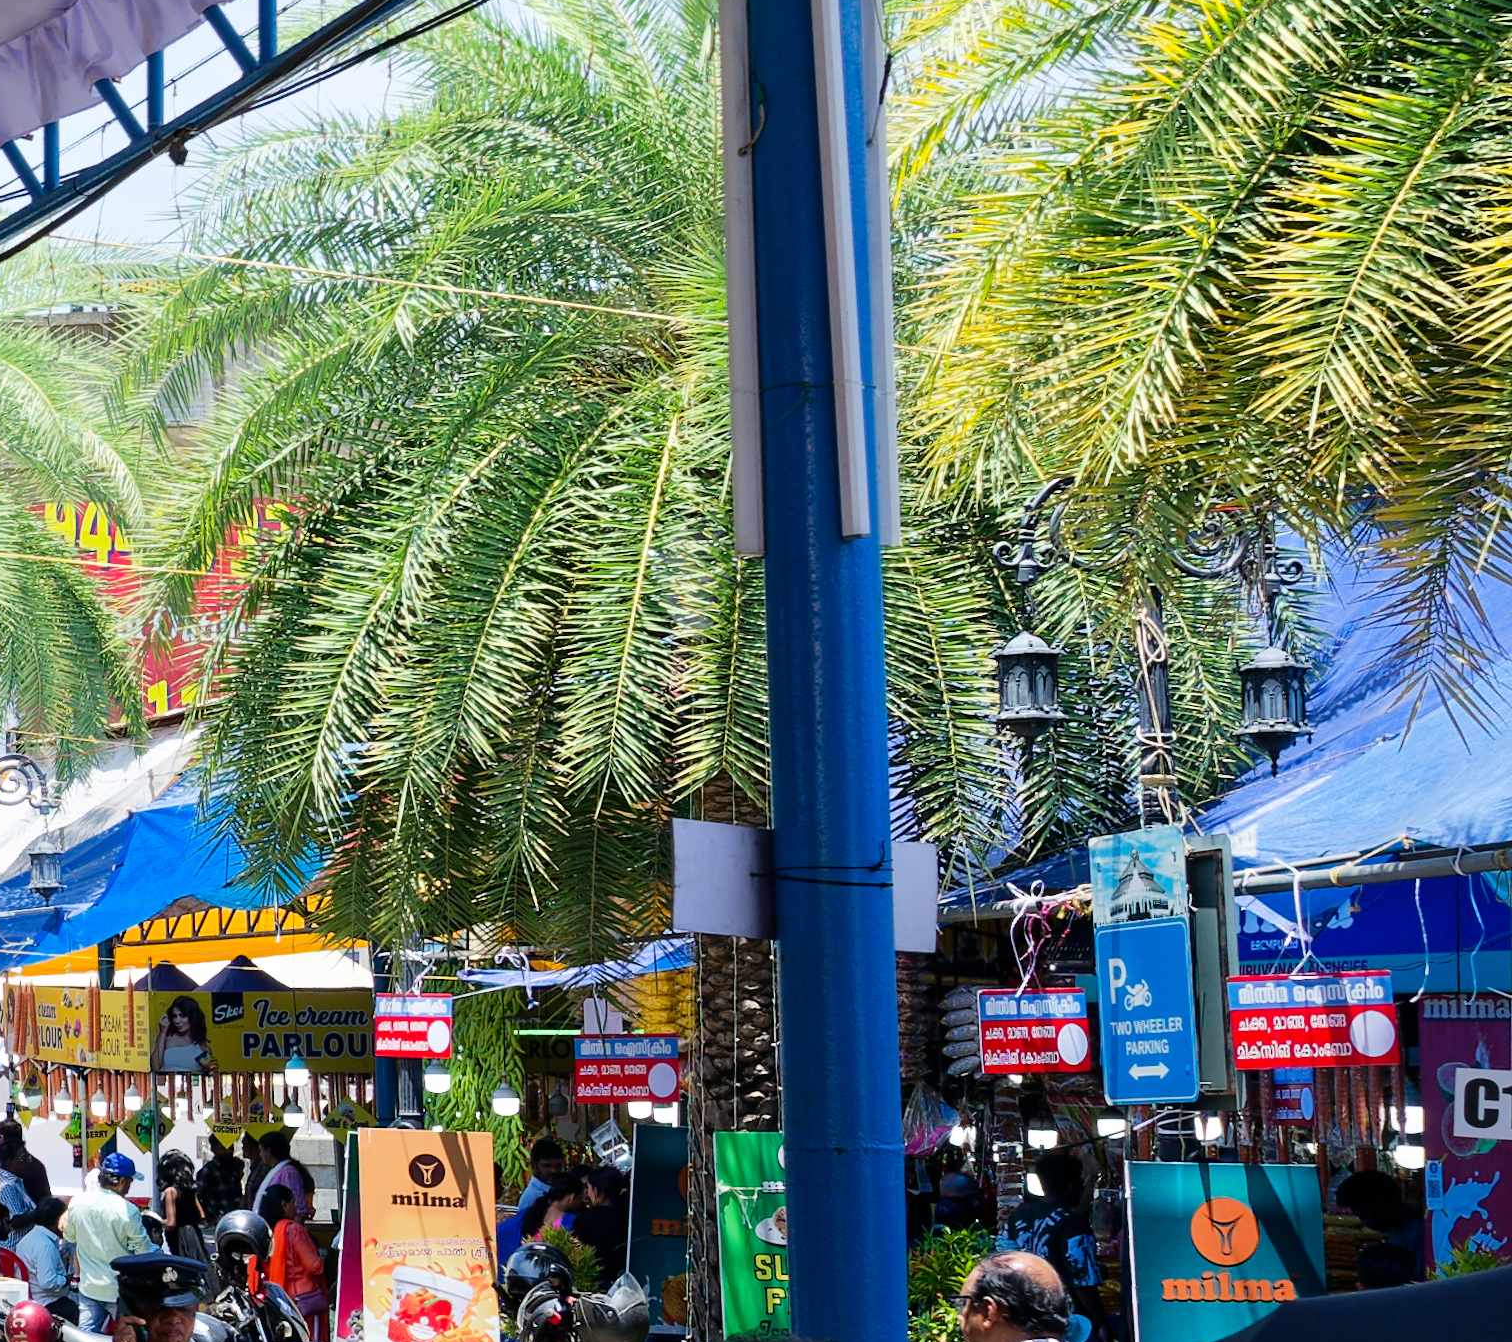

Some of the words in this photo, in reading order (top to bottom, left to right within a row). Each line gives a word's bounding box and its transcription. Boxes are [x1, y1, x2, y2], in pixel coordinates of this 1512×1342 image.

[1108, 957, 1127, 1004] P
[253, 999, 293, 1029] Ice
[295, 1010, 369, 1029] cream
[1423, 996, 1512, 1019] milma
[1111, 1021, 1132, 1036] TWO
[1134, 1017, 1183, 1035] WHEELER
[242, 1032, 374, 1058] PARLOU
[1126, 1039, 1169, 1056] PARKING
[391, 1191, 466, 1208] milma
[1161, 1270, 1298, 1302] milma
